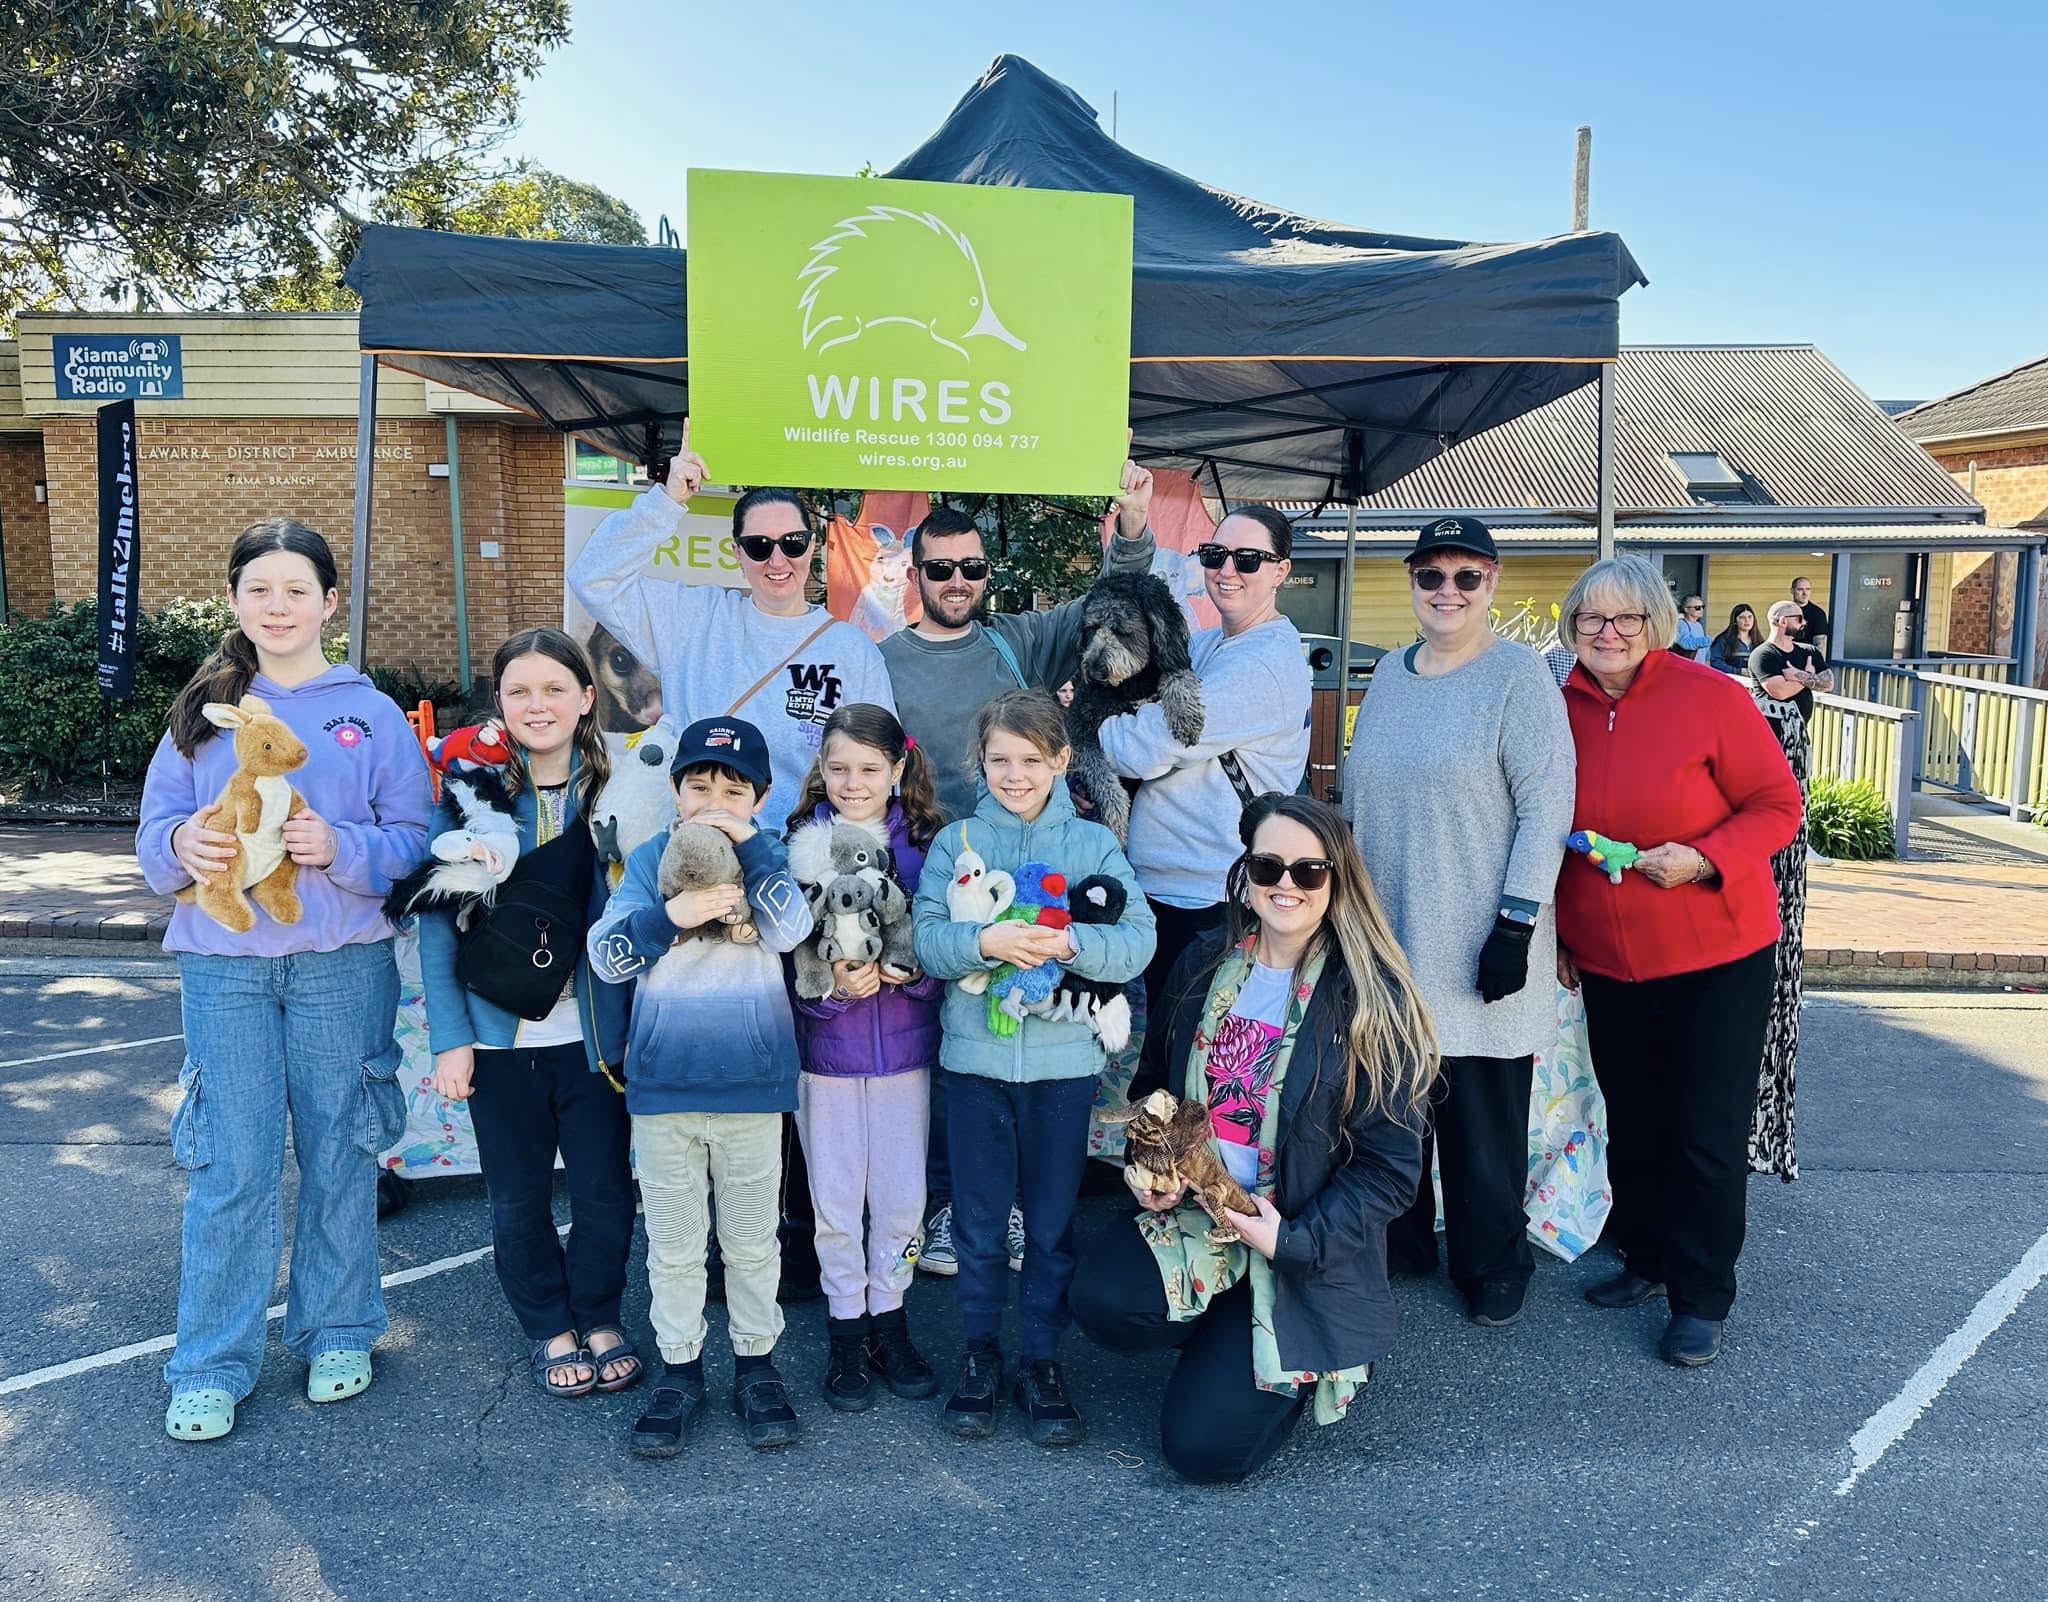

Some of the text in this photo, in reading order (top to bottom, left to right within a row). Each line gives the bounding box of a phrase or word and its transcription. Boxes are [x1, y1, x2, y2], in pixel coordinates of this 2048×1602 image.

[69, 346, 129, 365] Kiama
[64, 361, 172, 380] Community
[71, 374, 127, 394] Radio
[807, 374, 1012, 425] WIRES
[784, 426, 1040, 449] Wildlife Rescue 1300 094 737
[138, 446, 414, 460] LAWARRA DISTRICT AMBUANCE
[858, 452, 967, 471] wires.org.au
[223, 475, 315, 486] KIAMA BRANCH
[107, 421, 134, 654] #talk2mebro
[653, 534, 742, 571] RES
[1863, 577, 1893, 586] GENTS
[322, 716, 346, 733] STAY
